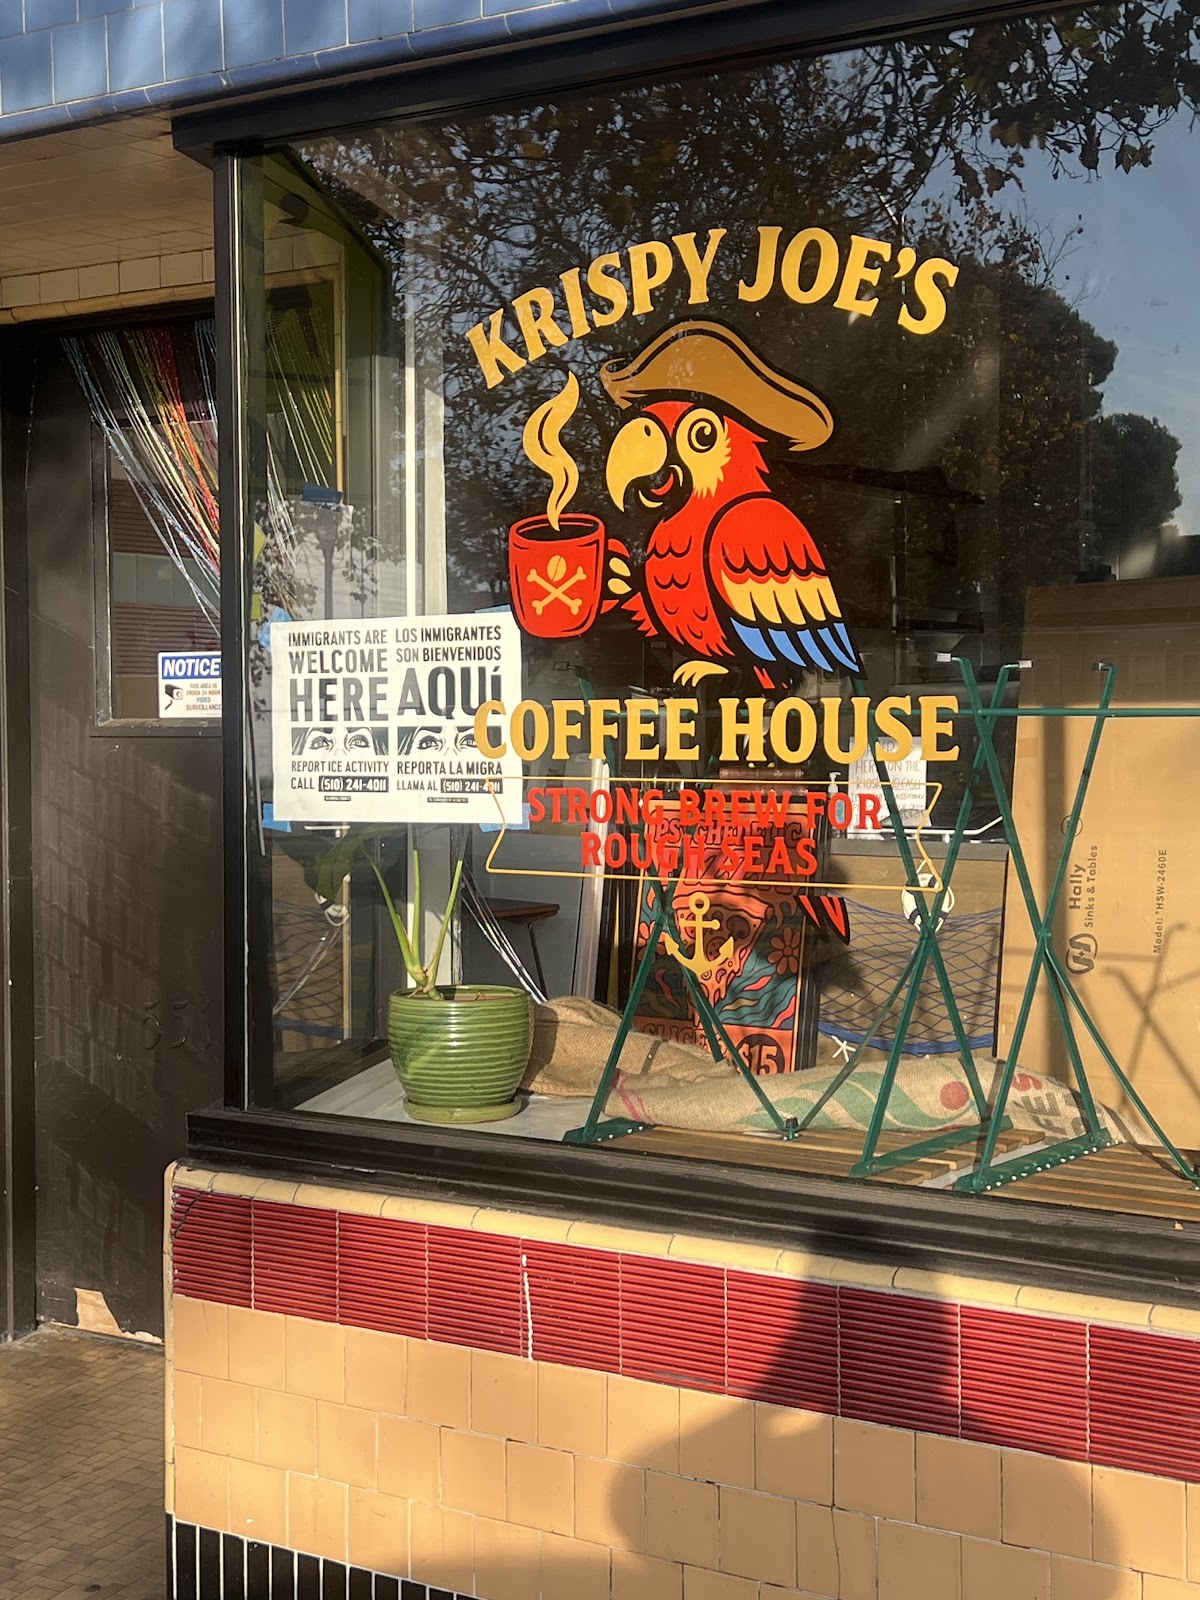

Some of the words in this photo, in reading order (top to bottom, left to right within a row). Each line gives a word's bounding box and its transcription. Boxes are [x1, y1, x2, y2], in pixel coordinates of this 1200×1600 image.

[466, 228, 727, 389] KRISPY
[738, 225, 959, 335] JOE'S
[288, 630, 361, 647] IMMIGRANTS
[364, 629, 388, 644] ARE
[395, 628, 417, 643] LOS
[420, 625, 502, 642] INMIGRANTES
[288, 649, 388, 674] WELCOME
[396, 647, 419, 663] SON
[423, 645, 502, 662] BIENVENIDOS
[163, 658, 221, 677] NOTICE
[289, 676, 389, 722] HERE
[397, 665, 502, 720] AQUÍ
[473, 697, 700, 761] COFFEE
[719, 695, 960, 765] HOUSE
[291, 760, 326, 773] REPORT
[328, 760, 343, 773] ICE
[345, 760, 389, 773] ACTIVITY
[397, 761, 446, 775] REPORTA
[449, 761, 464, 775] LA
[466, 760, 503, 775] MIGRA
[856, 759, 878, 774] HER
[291, 777, 315, 790] CALL
[320, 777, 344, 792] (510)
[345, 777, 387, 791] 241-4011
[397, 779, 425, 791] LLAMA
[426, 779, 438, 791] AL
[443, 779, 463, 792] (510)
[528, 787, 664, 826] STRONG
[679, 788, 790, 829] BREW
[806, 793, 883, 831] FOR
[581, 832, 714, 872] ROUGH
[722, 837, 818, 877] SEAS
[1086, 845, 1098, 883] Tables
[1069, 864, 1086, 910] Hally
[1086, 886, 1096, 894] &
[1084, 897, 1095, 928] Sinks
[1153, 917, 1164, 954] Model:
